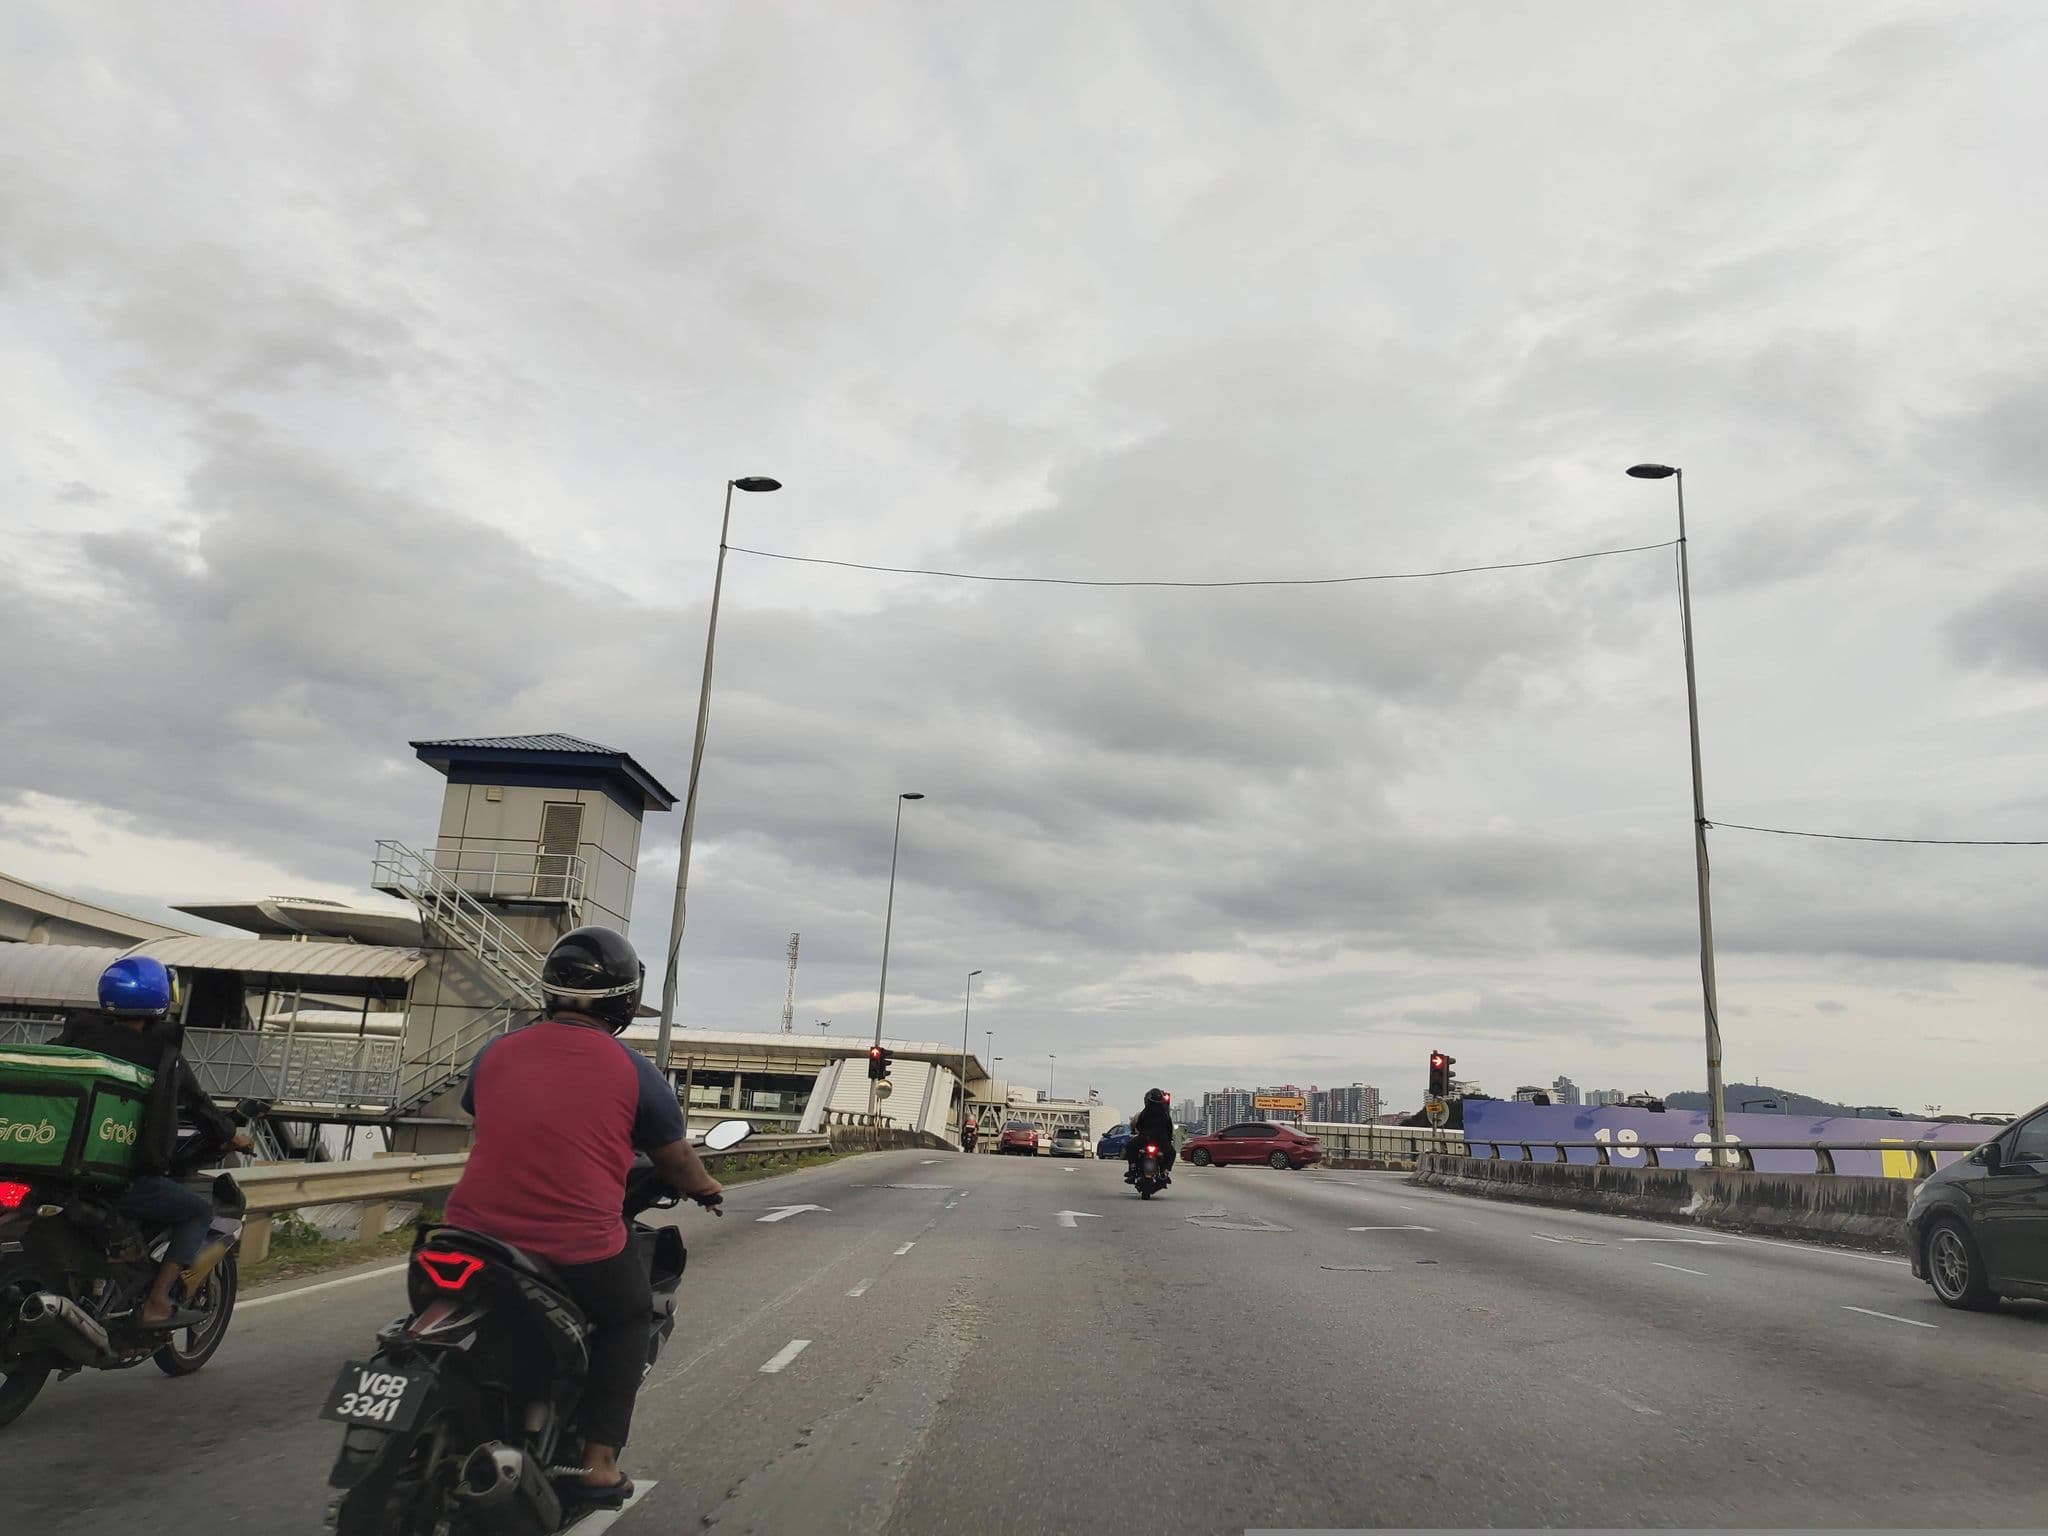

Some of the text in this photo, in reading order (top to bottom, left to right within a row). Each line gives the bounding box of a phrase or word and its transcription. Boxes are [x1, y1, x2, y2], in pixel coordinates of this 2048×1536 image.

[99, 1117, 137, 1146] Grab
[1594, 1128, 1640, 1159] 18
[358, 1371, 408, 1398] VGB
[336, 1392, 401, 1422] 3341
